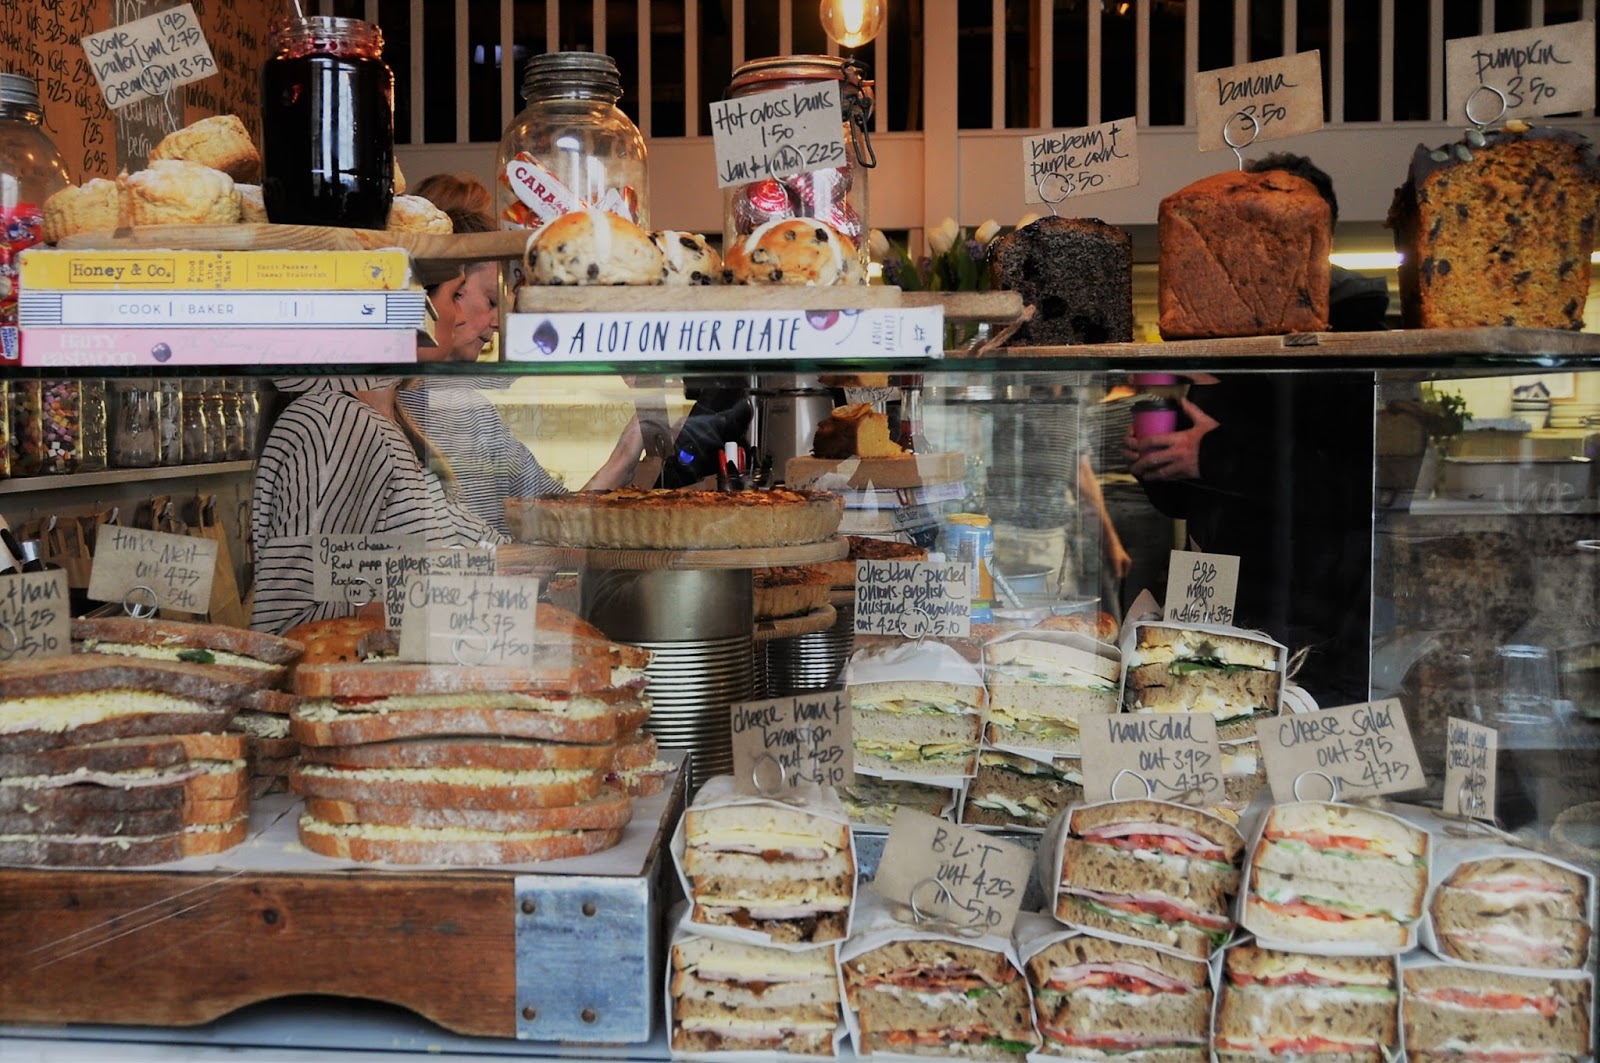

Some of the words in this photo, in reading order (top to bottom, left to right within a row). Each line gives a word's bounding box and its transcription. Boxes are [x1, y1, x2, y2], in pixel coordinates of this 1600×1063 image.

[168, 27, 200, 53] 2.75
[180, 54, 213, 78] 3.50
[1471, 40, 1571, 84] pumpkin
[1217, 73, 1298, 106] banana
[1506, 76, 1556, 109] 3.50
[715, 103, 747, 135] Hot
[1240, 103, 1286, 131] 3.50
[762, 124, 793, 147] 1.50
[1032, 130, 1104, 159] blueberry
[1031, 154, 1081, 185] purple
[73, 264, 124, 280] Honey
[131, 264, 142, 276] &
[147, 264, 172, 278] Co.
[118, 304, 161, 315] COOK
[188, 304, 234, 314] BAKER
[569, 322, 585, 354] A
[596, 321, 633, 353] LOT
[638, 320, 670, 352] ON
[678, 319, 721, 352] HER
[732, 317, 800, 352] PLATE
[331, 555, 353, 570] Red
[1192, 561, 1217, 588] egg
[1139, 747, 1170, 771] out
[1317, 739, 1352, 767] out
